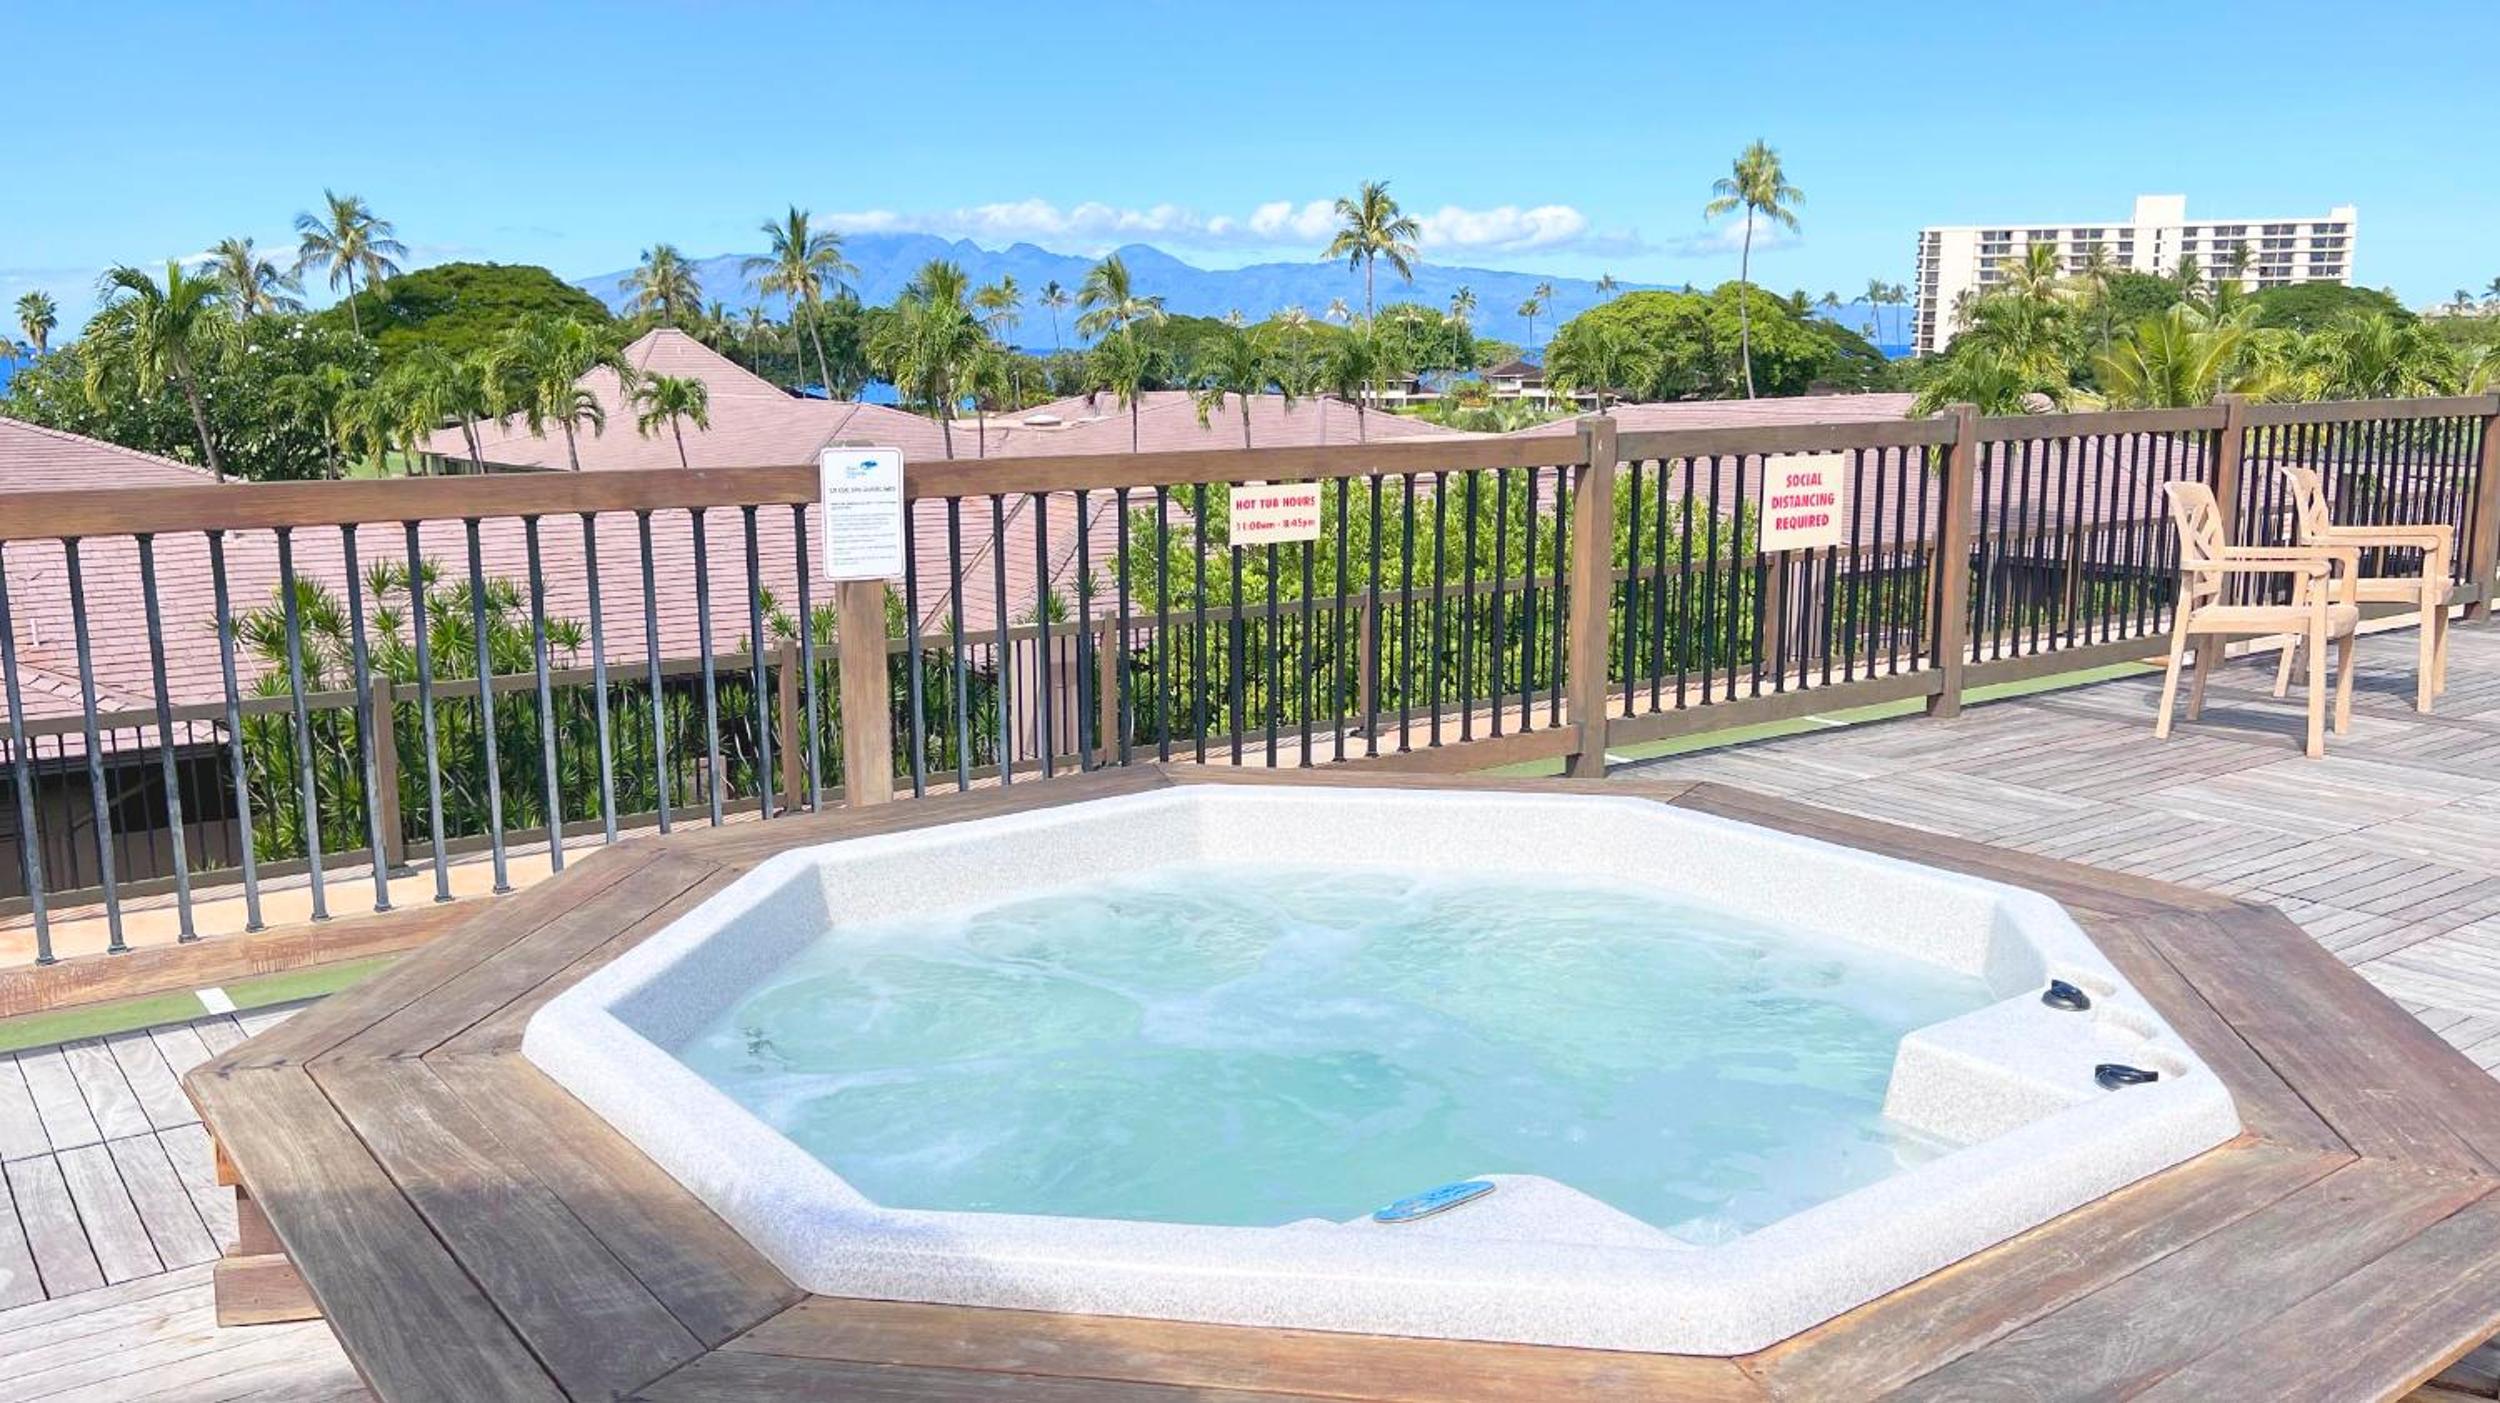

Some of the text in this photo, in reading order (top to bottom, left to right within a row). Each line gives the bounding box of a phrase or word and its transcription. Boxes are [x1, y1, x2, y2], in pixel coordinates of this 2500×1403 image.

[1786, 473, 1822, 487] SOCIAL
[1236, 496, 1316, 510] HOT TUB HOURS
[1771, 493, 1835, 509] DISTANCING
[1775, 514, 1829, 530] REQUIRED
